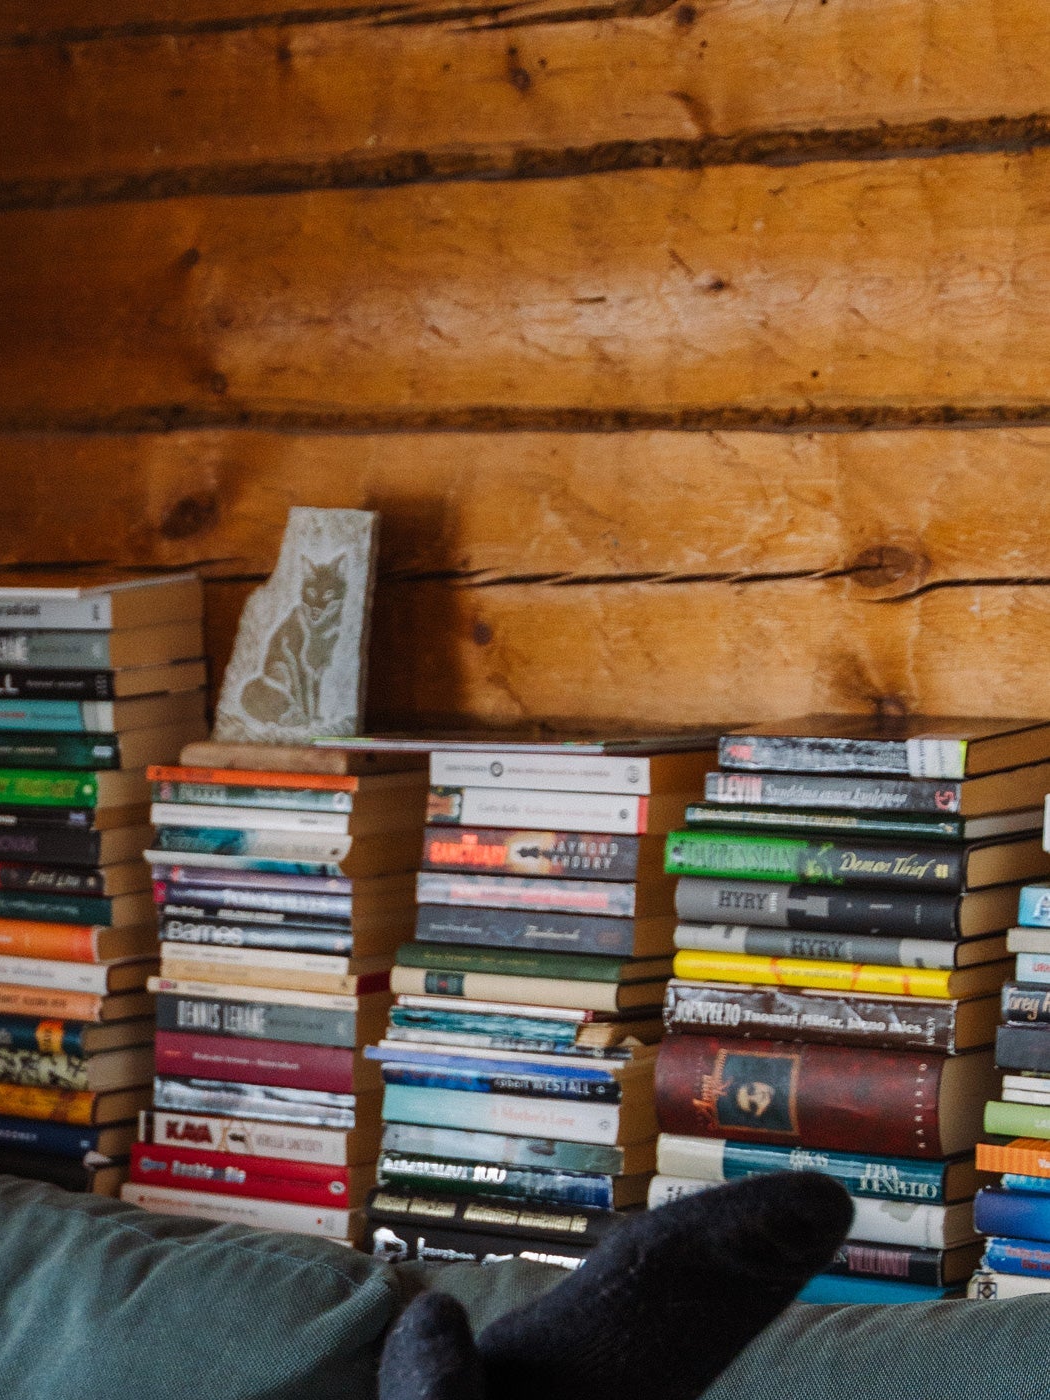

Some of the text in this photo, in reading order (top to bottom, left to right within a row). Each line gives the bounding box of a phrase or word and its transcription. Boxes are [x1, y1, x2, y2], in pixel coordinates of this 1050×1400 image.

[839, 852, 938, 880] Demon Thief
[718, 890, 769, 910] HYRY
[791, 939, 844, 958] HYRY
[177, 1001, 221, 1029] DENNIS
[533, 1077, 591, 1095] WESTALL
[915, 1062, 929, 1150] KARISTO
